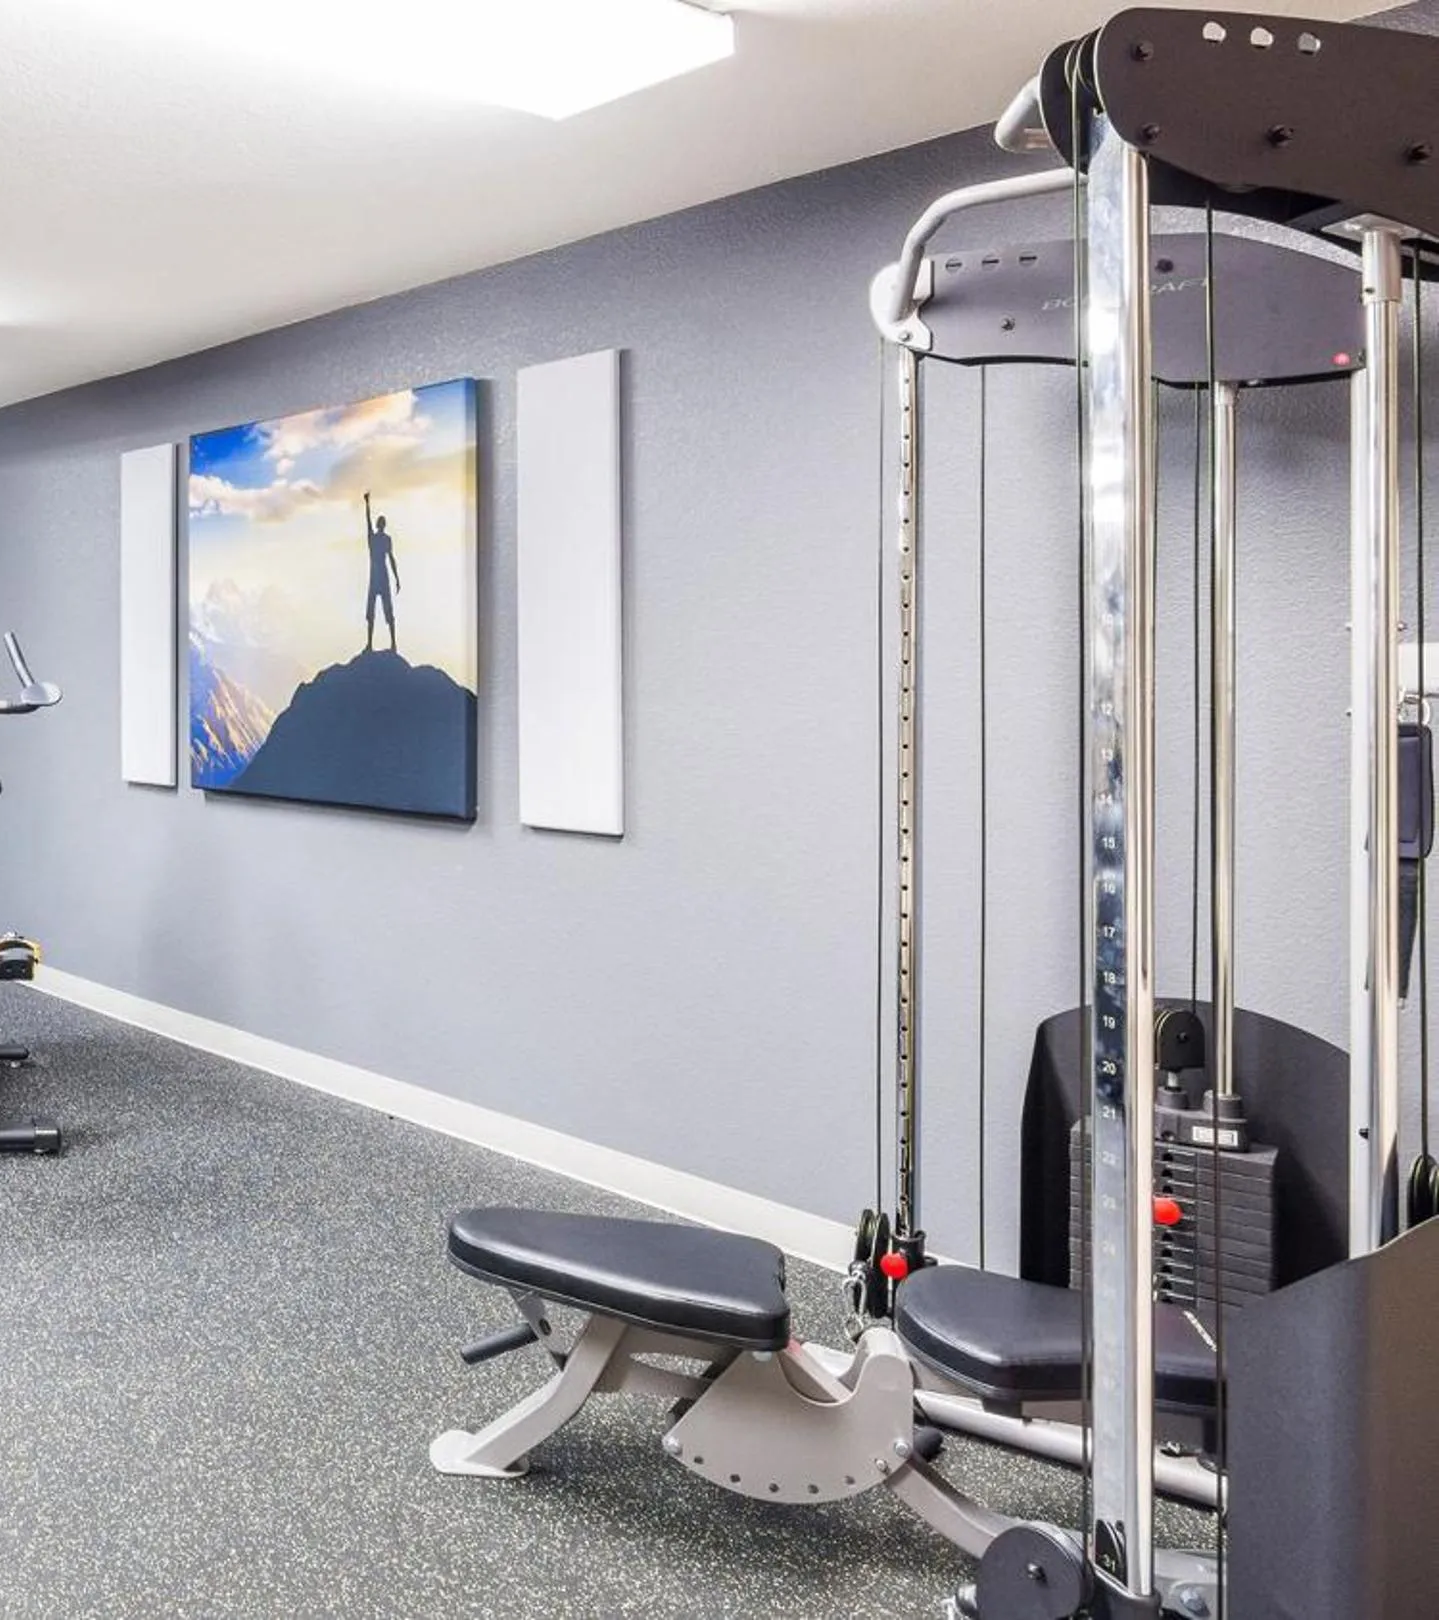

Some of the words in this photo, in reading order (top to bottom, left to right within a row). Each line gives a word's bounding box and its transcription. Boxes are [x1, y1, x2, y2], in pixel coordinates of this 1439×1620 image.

[1101, 701, 1114, 716] 12
[1102, 836, 1116, 850] 15
[1102, 882, 1116, 896] 16
[1103, 926, 1115, 939] 17
[1103, 971, 1116, 985] 18
[1102, 1015, 1116, 1029] 19
[1102, 1060, 1117, 1075] 20
[1102, 1105, 1116, 1120] 21
